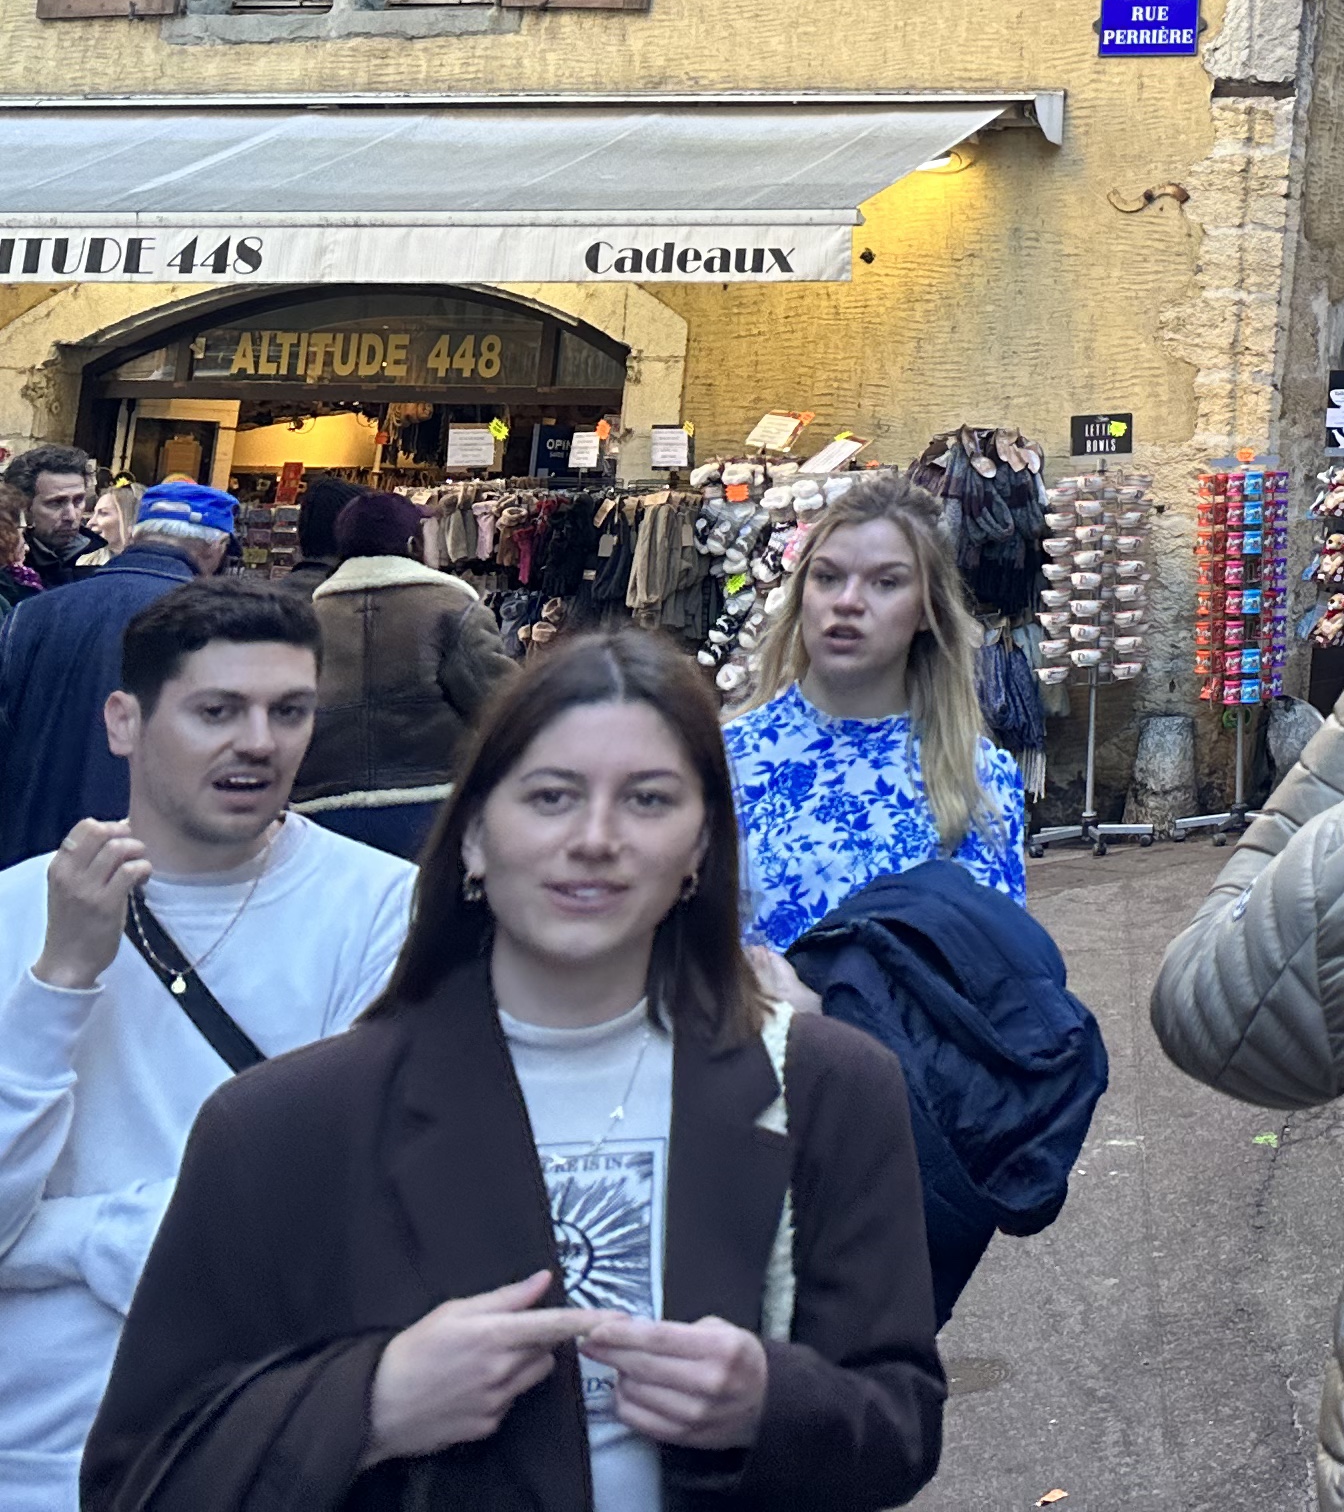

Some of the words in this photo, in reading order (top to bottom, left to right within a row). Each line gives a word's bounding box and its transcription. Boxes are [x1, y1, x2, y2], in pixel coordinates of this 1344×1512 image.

[1131, 6, 1169, 21] RUE
[1103, 26, 1193, 45] PERRIÈRE
[166, 235, 263, 275] 448
[585, 241, 796, 275] Cadeaux
[229, 332, 411, 376] ALTITUDE
[427, 334, 502, 378] 448
[1086, 439, 1116, 452] BOWLS
[582, 1155, 599, 1172] IS
